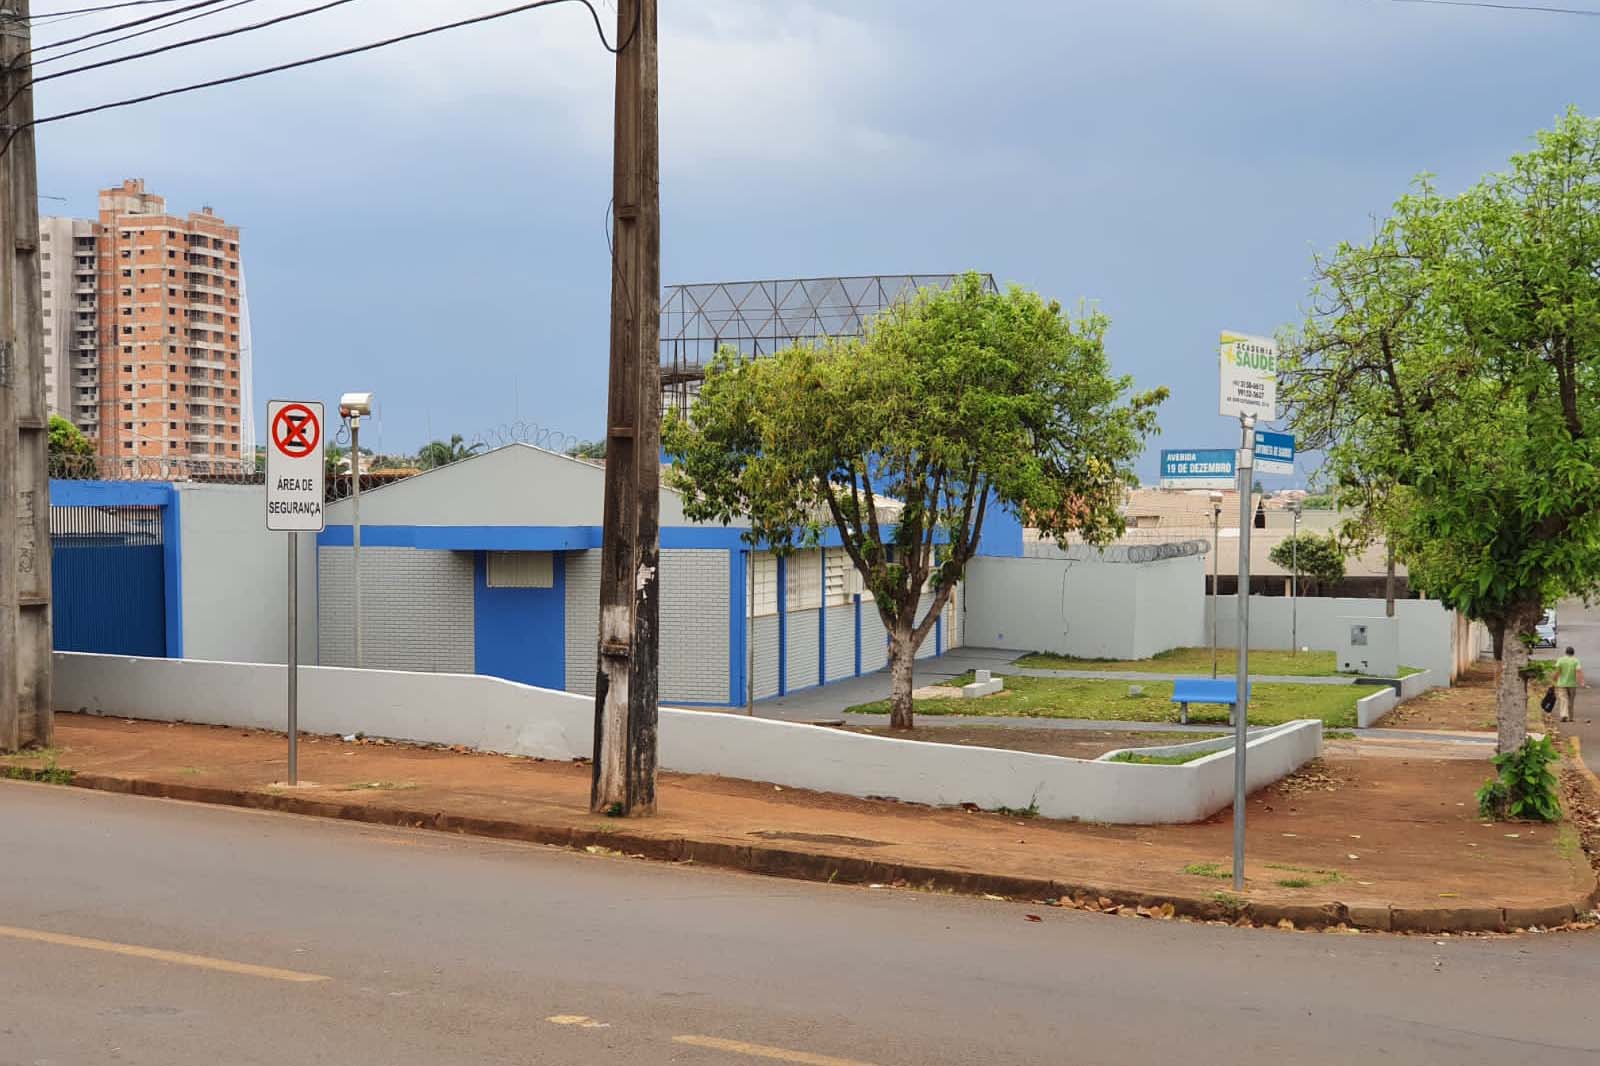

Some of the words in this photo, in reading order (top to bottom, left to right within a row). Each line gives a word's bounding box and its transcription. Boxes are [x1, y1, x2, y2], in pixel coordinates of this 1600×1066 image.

[1236, 343, 1272, 355] ACADEMIA
[1167, 453, 1196, 462] AVENIDA
[1167, 463, 1176, 473] 19
[1177, 463, 1188, 473] DE
[1189, 462, 1232, 473] DEZEMBRO
[277, 474, 301, 491] ÁREA
[302, 478, 313, 491] DE
[269, 501, 321, 517] SEGURANÇA
